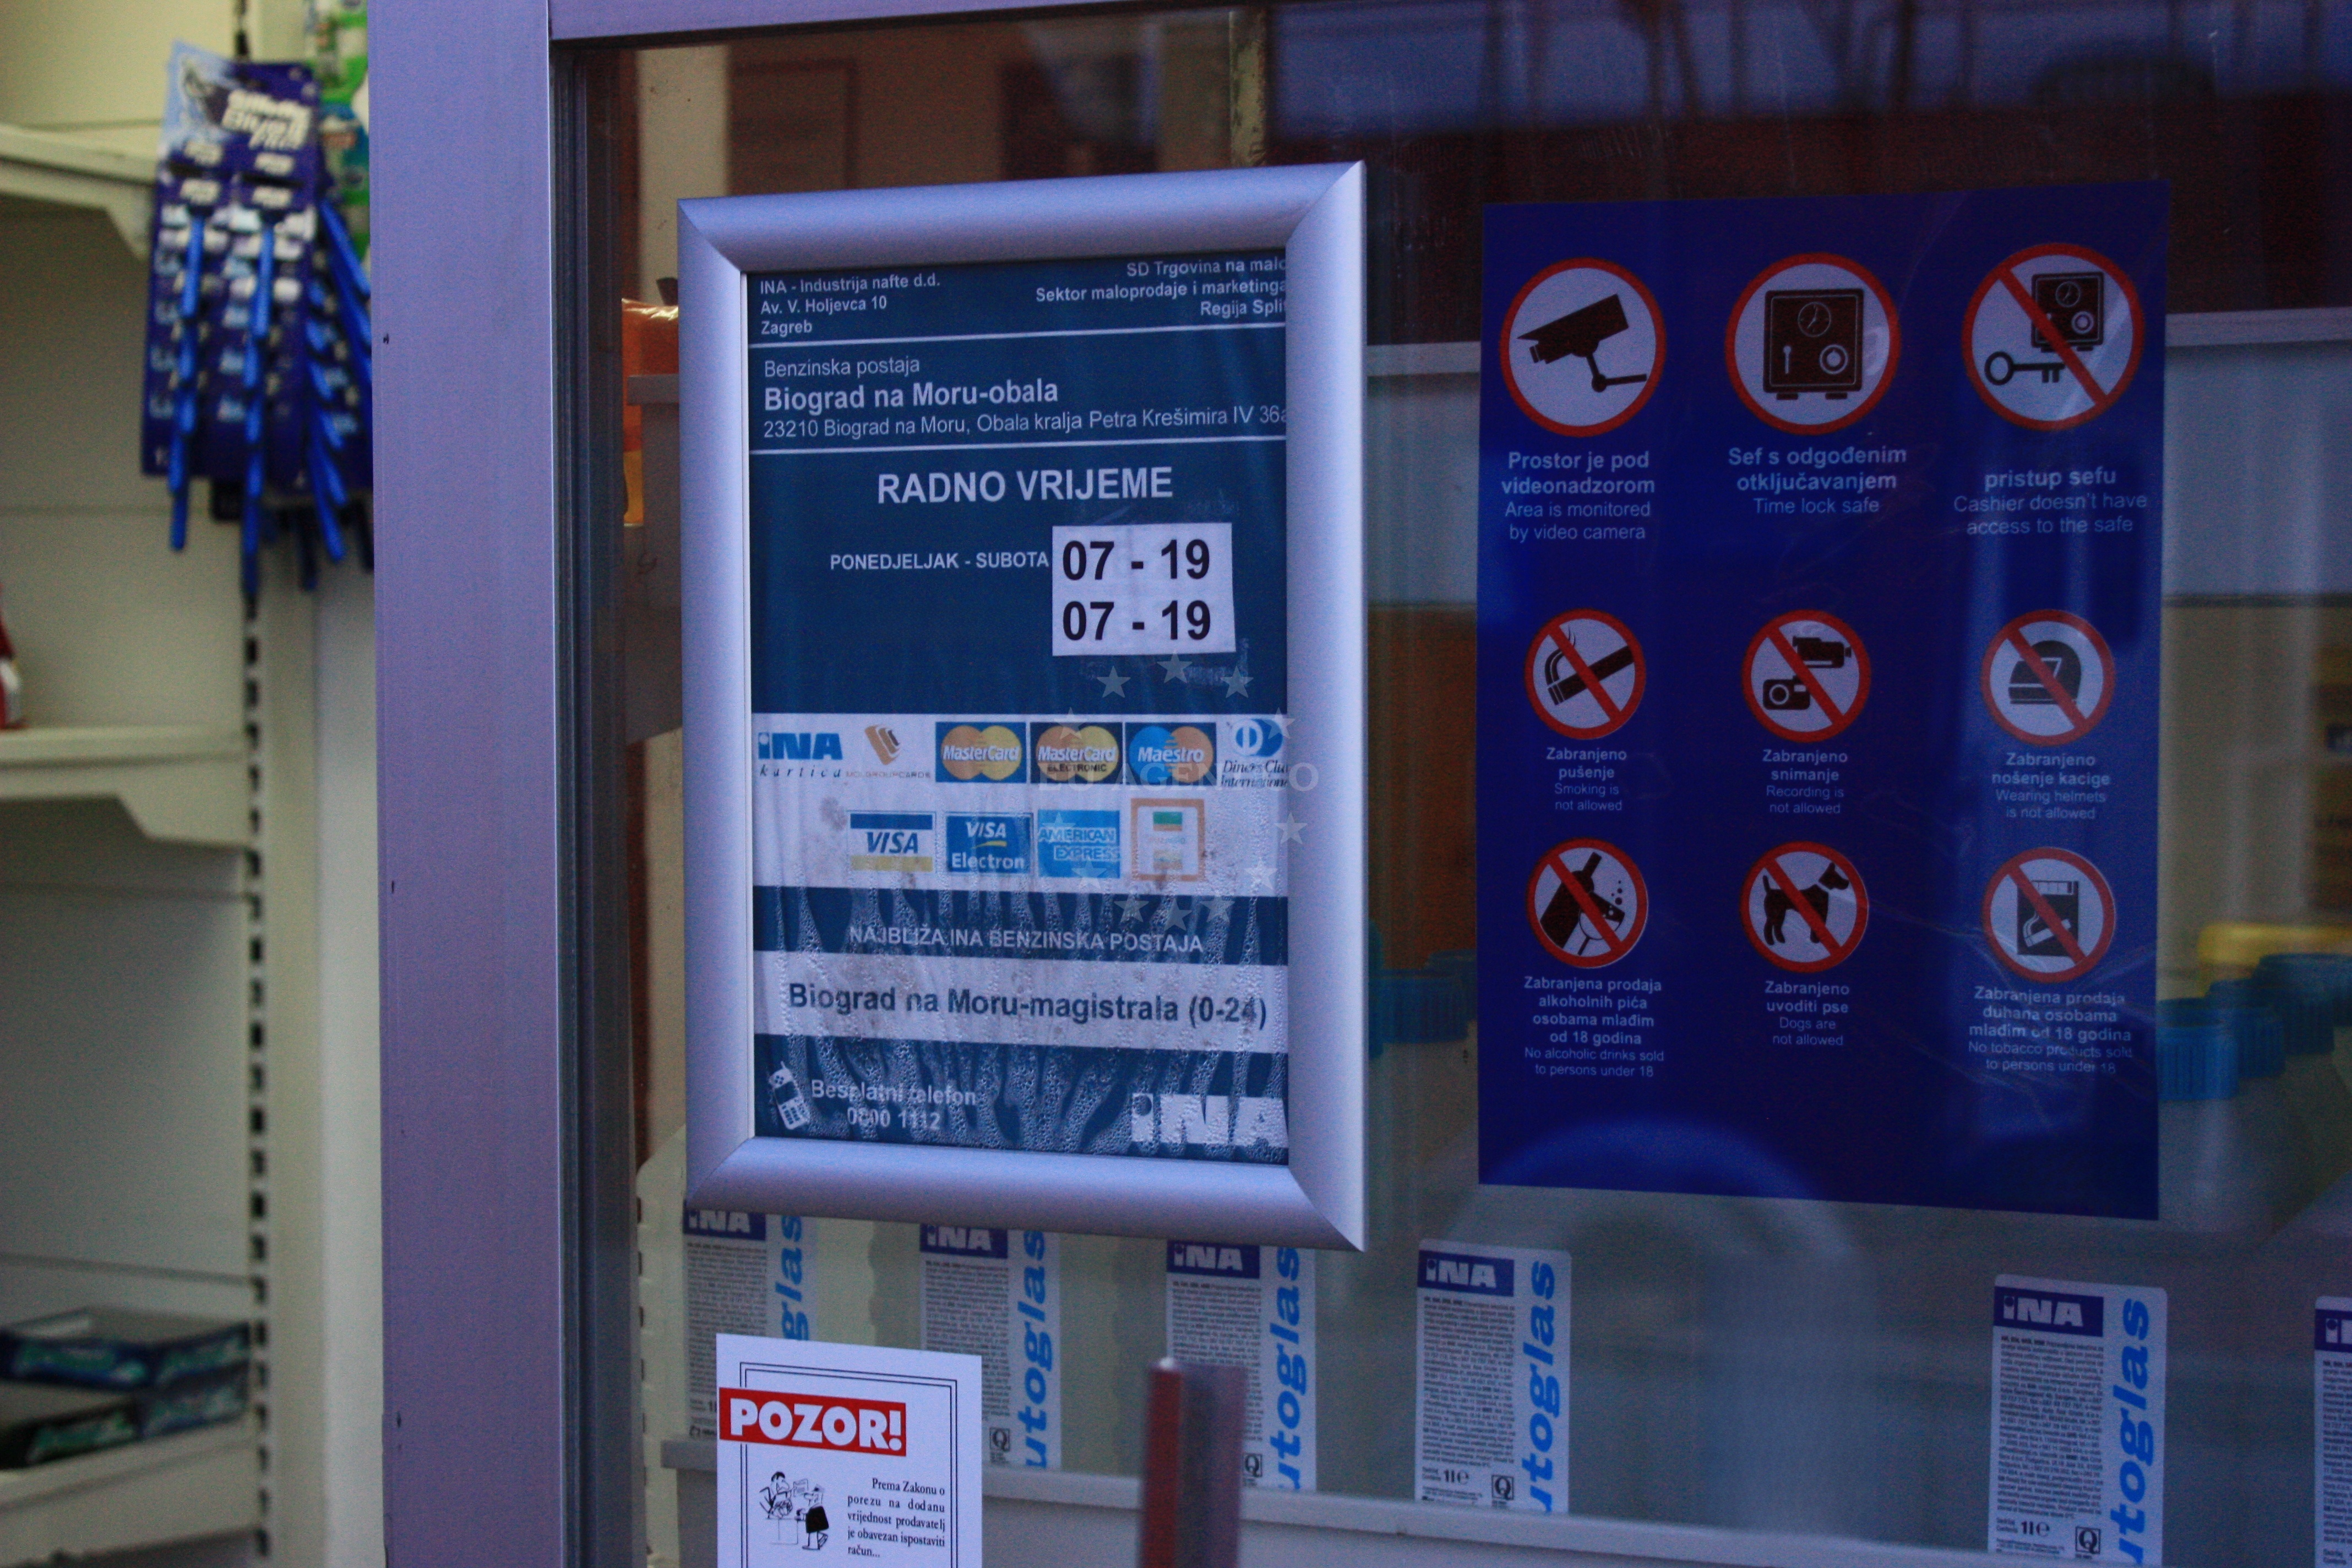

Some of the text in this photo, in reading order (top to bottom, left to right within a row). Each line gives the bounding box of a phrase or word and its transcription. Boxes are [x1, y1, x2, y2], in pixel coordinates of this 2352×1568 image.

[1127, 262, 1149, 276] SD
[1154, 259, 1221, 278] Trgovina
[760, 273, 940, 295] INA Industrija nafte d.d.
[1036, 286, 1087, 302] Sektor
[1092, 282, 1187, 301] maloprodaje
[760, 295, 887, 315] Av. V. Holjevca 10
[1201, 298, 1286, 319] Regija Spli
[761, 319, 813, 337] Zagreb
[765, 356, 919, 379] Benzinska postaja
[765, 378, 1058, 416] Biograd na Moru-obala
[764, 420, 818, 438] 23210
[824, 417, 889, 439] Biograd
[895, 420, 915, 434] na
[921, 416, 971, 435] Moru,
[977, 413, 1028, 432] Obala
[1035, 412, 1082, 434] kralja
[1090, 410, 1137, 428] Petra
[1142, 406, 1227, 427] Krešimira
[1233, 405, 1254, 424] IV
[1509, 450, 1649, 472] Prostor je pod
[1728, 447, 1763, 465] Sef
[878, 466, 1173, 504] RADNO VRIJEME
[1501, 477, 1655, 494] videonadzorom
[1736, 472, 1897, 494] otključavanjem
[1985, 466, 2116, 492] pristup sefu
[1505, 501, 1651, 518] Area is monitored
[1754, 497, 1880, 514] Time lock safe
[1954, 492, 2147, 511] Cashier doesn't have
[1510, 524, 1646, 543] by video camera
[1967, 516, 2133, 535] access to the safe
[830, 551, 1049, 571] PONEDJELJAK SUBOTA
[1063, 538, 1210, 581] 07 19
[1063, 600, 1211, 641] 07 19
[943, 745, 1020, 762] MasterCard
[1037, 745, 1117, 763] MasterCard
[1138, 747, 1205, 763] Maestro
[1546, 747, 1627, 763] Zabranjeno
[1762, 749, 1848, 765] Zabranjeno
[2006, 752, 2095, 769] Zabranjeno
[1559, 766, 1615, 781] pušenje
[1771, 768, 1839, 784] snimanje
[2059, 772, 2111, 788] kacige
[1554, 782, 1605, 797] Smoking
[1766, 785, 1830, 799] Recording
[1996, 789, 2106, 804] Wearing helmets
[1577, 800, 1622, 810] allowed
[1793, 802, 1841, 814] allowed
[2045, 807, 2095, 819] allowed
[966, 822, 1007, 838] VISA
[1038, 828, 1116, 842] AMERICAN
[867, 832, 919, 854] VISA
[951, 852, 1025, 869] Electron
[951, 929, 983, 947] INA
[991, 929, 1104, 950] BENZINSKA
[1111, 933, 1204, 952] POSTAJA
[1524, 976, 1662, 994] Zabranjena prodaja
[1765, 980, 1849, 998] Zabranjeno
[1539, 995, 1612, 1008] alkoholnih
[1974, 986, 2125, 1007] Zabranjena prodaja
[789, 983, 1267, 1030] Biograd na Moru-magistrala (0-24)
[1767, 1000, 1849, 1015] uvoditi pse
[1983, 1005, 2117, 1022] duhana osobama
[1533, 1013, 1597, 1025] osobama
[1779, 1017, 1811, 1031] Dogs
[1550, 1031, 1641, 1047] od 18 godina
[1796, 1035, 1843, 1046] allowed
[2031, 1027, 2049, 1038] od
[2056, 1027, 2072, 1040] 18
[2078, 1028, 2131, 1044] godina
[1545, 1048, 1664, 1061] alcoholic drinks sold
[1991, 1042, 2043, 1055] tobacco
[1550, 1065, 1653, 1077] persons under 18
[2002, 1060, 2095, 1072] persons under
[730, 1398, 902, 1451] POZOR!
[872, 1477, 937, 1496] Prema Zakonu
[847, 1495, 945, 1513] porezu na dodanu
[847, 1511, 945, 1533] vrijednost prodavatelj
[857, 1529, 945, 1548] obavezan ispostaviti
